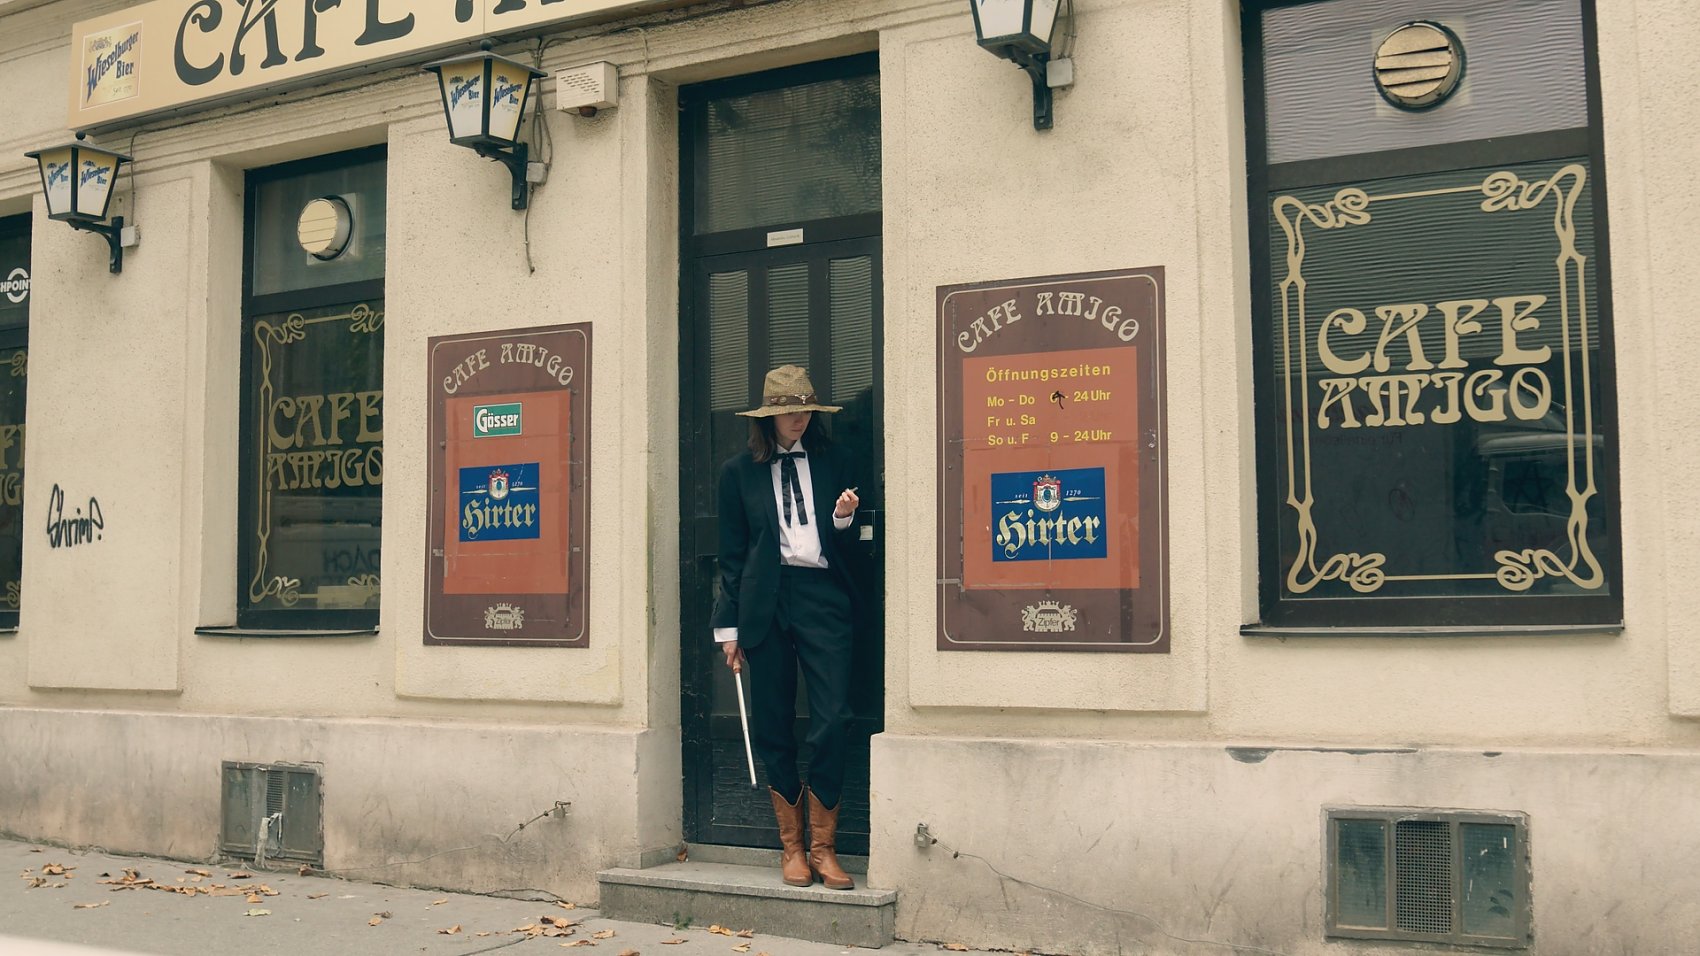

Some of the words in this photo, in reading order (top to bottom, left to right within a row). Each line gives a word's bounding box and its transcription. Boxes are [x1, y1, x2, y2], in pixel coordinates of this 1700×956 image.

[86, 31, 139, 103] Wieselburger
[115, 59, 134, 79] Bier
[957, 299, 1022, 353] CAFE
[1036, 291, 1140, 342] AMIGO
[1318, 295, 1551, 375] CAFE
[443, 348, 491, 394] CAFE
[500, 342, 574, 386] AMIGO
[986, 364, 1111, 382] Öffnungszeiten
[987, 396, 1005, 407] Mo
[1019, 394, 1036, 406] Do
[1318, 367, 1551, 429] AMIGO
[268, 391, 383, 449] CAFE
[476, 408, 519, 433] Gösser
[987, 416, 1000, 427] Fr
[1006, 418, 1016, 426] u.
[1020, 414, 1036, 426] Sa
[988, 435, 1004, 446] So
[1007, 436, 1017, 445] u.
[1021, 433, 1030, 444] F
[1050, 432, 1059, 443] 9
[266, 446, 383, 492] AMIGO
[1065, 489, 1081, 497] 1270
[462, 497, 536, 540] Hirter
[996, 508, 1101, 559] Hirter
[1038, 617, 1060, 629] Zipfer
